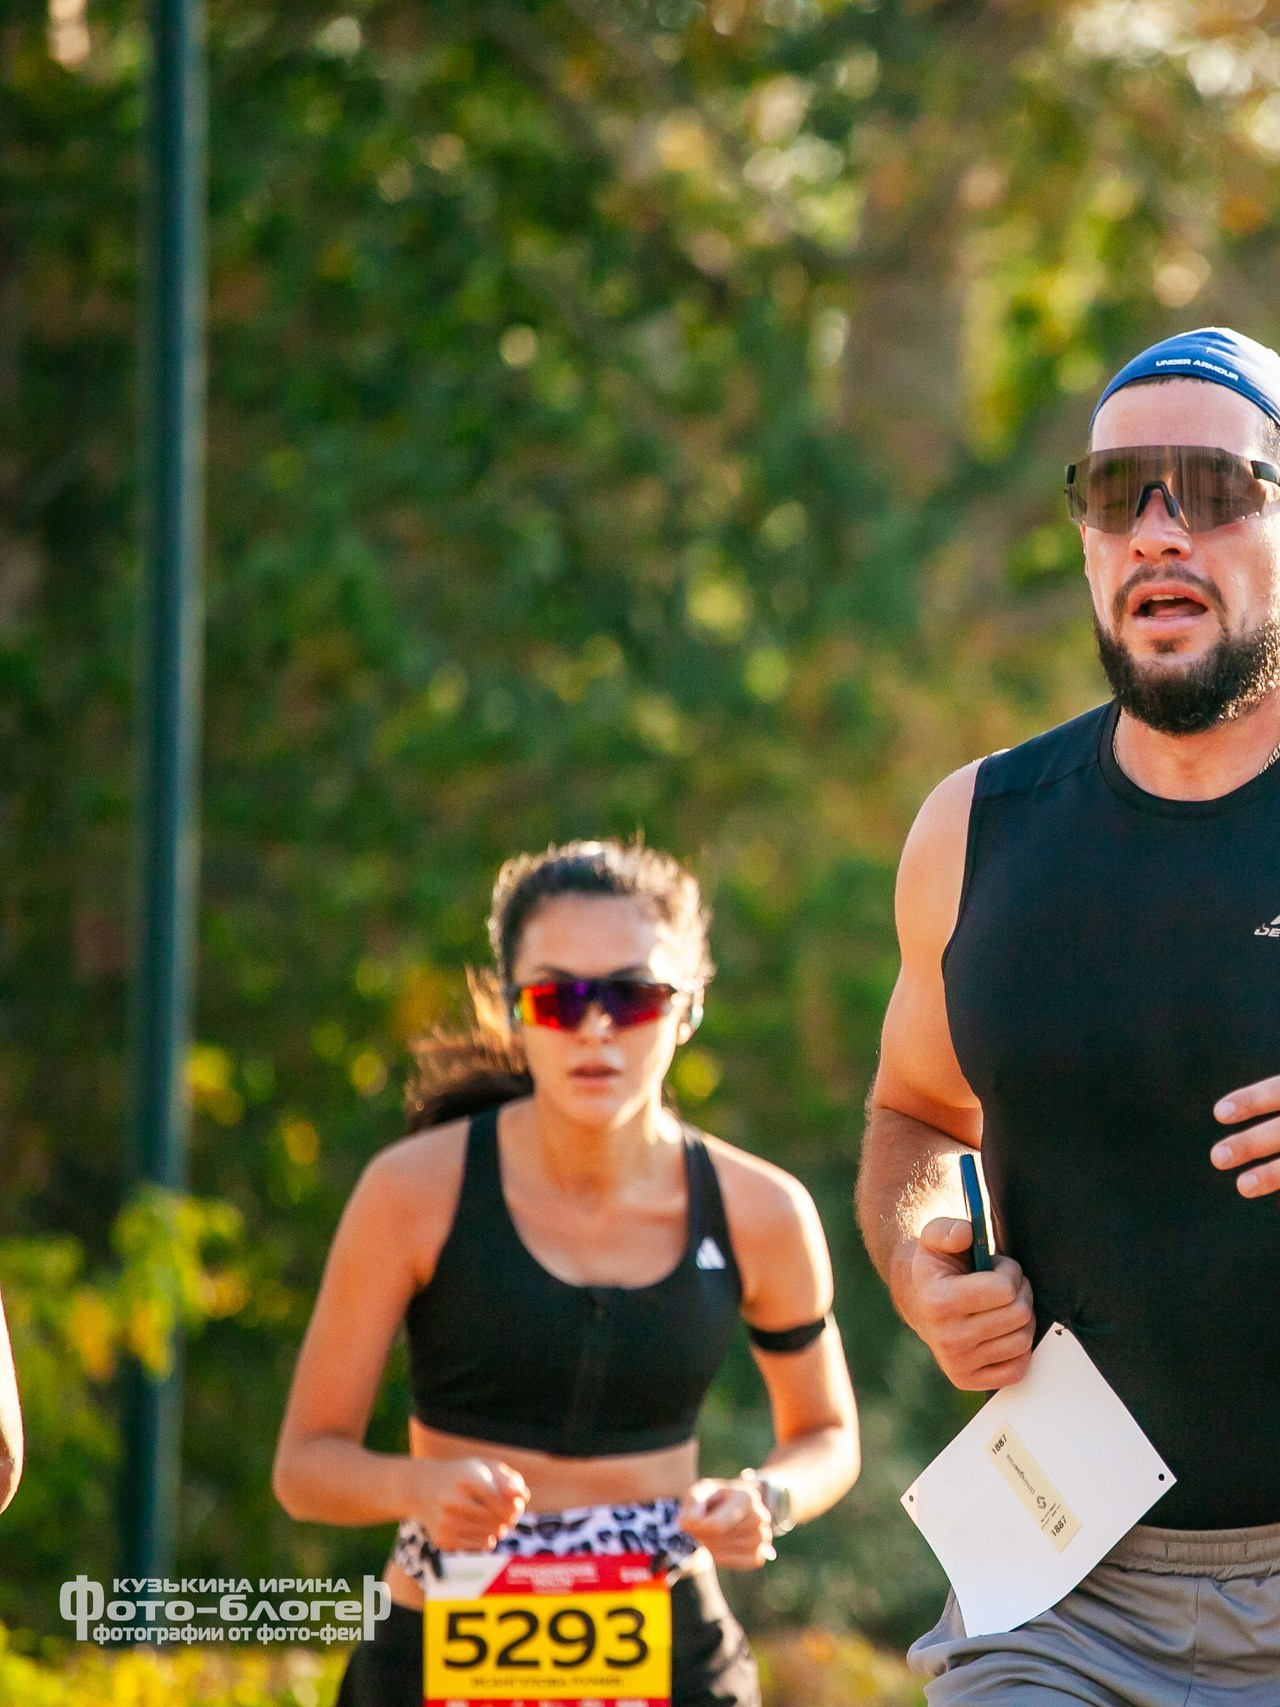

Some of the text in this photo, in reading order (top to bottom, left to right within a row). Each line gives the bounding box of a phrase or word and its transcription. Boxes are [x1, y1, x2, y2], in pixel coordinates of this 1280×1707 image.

[1193, 360, 1239, 381] ARMOUR
[991, 1434, 1008, 1455] 1887
[1051, 1515, 1067, 1537] 1887
[443, 1607, 649, 1670] 5293
